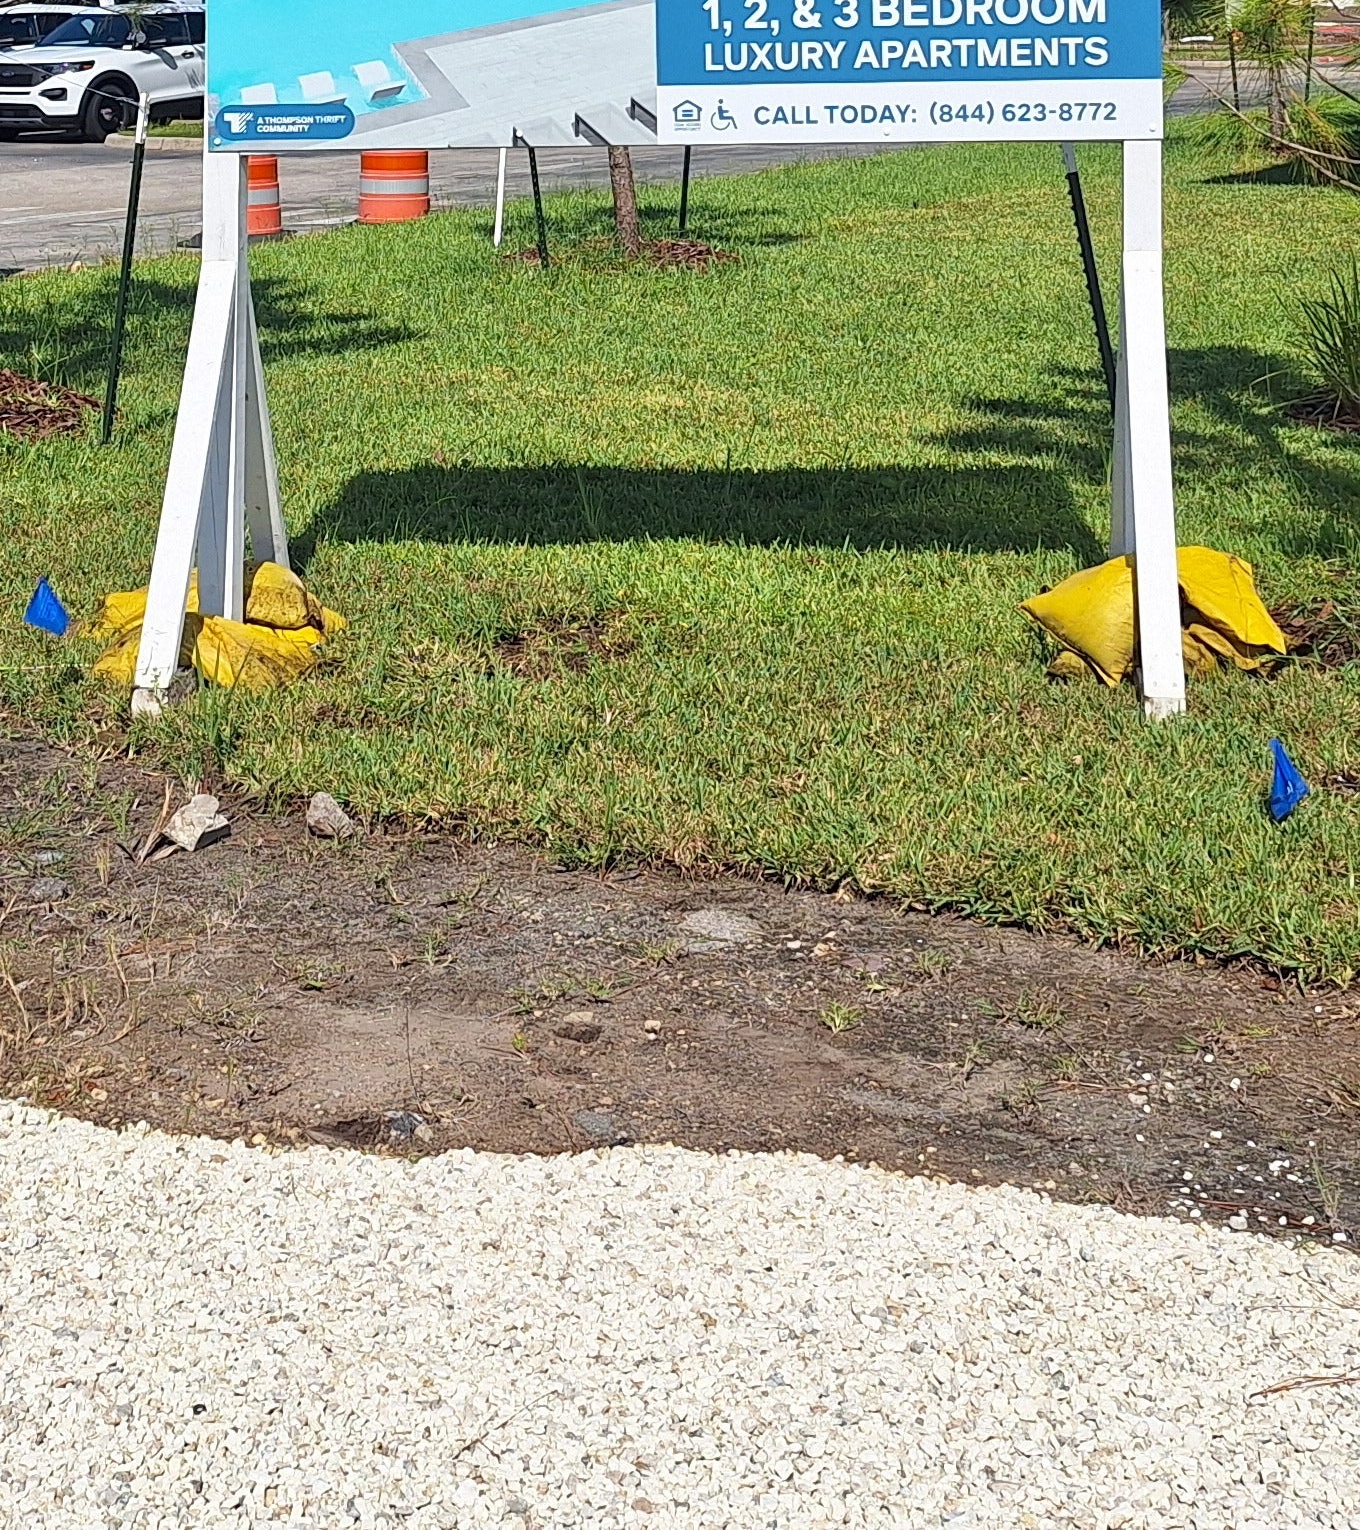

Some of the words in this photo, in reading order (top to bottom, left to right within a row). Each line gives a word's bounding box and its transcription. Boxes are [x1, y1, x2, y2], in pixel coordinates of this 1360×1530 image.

[704, 41, 846, 71] LUXURY
[853, 36, 1109, 69] APARTMENTS
[256, 116, 264, 125] A
[265, 115, 314, 125] THOMPSON
[315, 115, 346, 124] THRIFT
[753, 105, 819, 126] CALL
[823, 104, 917, 124] TODAY:
[929, 100, 995, 126] (844)
[1001, 101, 1117, 123] 623-8772
[256, 124, 310, 133] COMMUNITY
